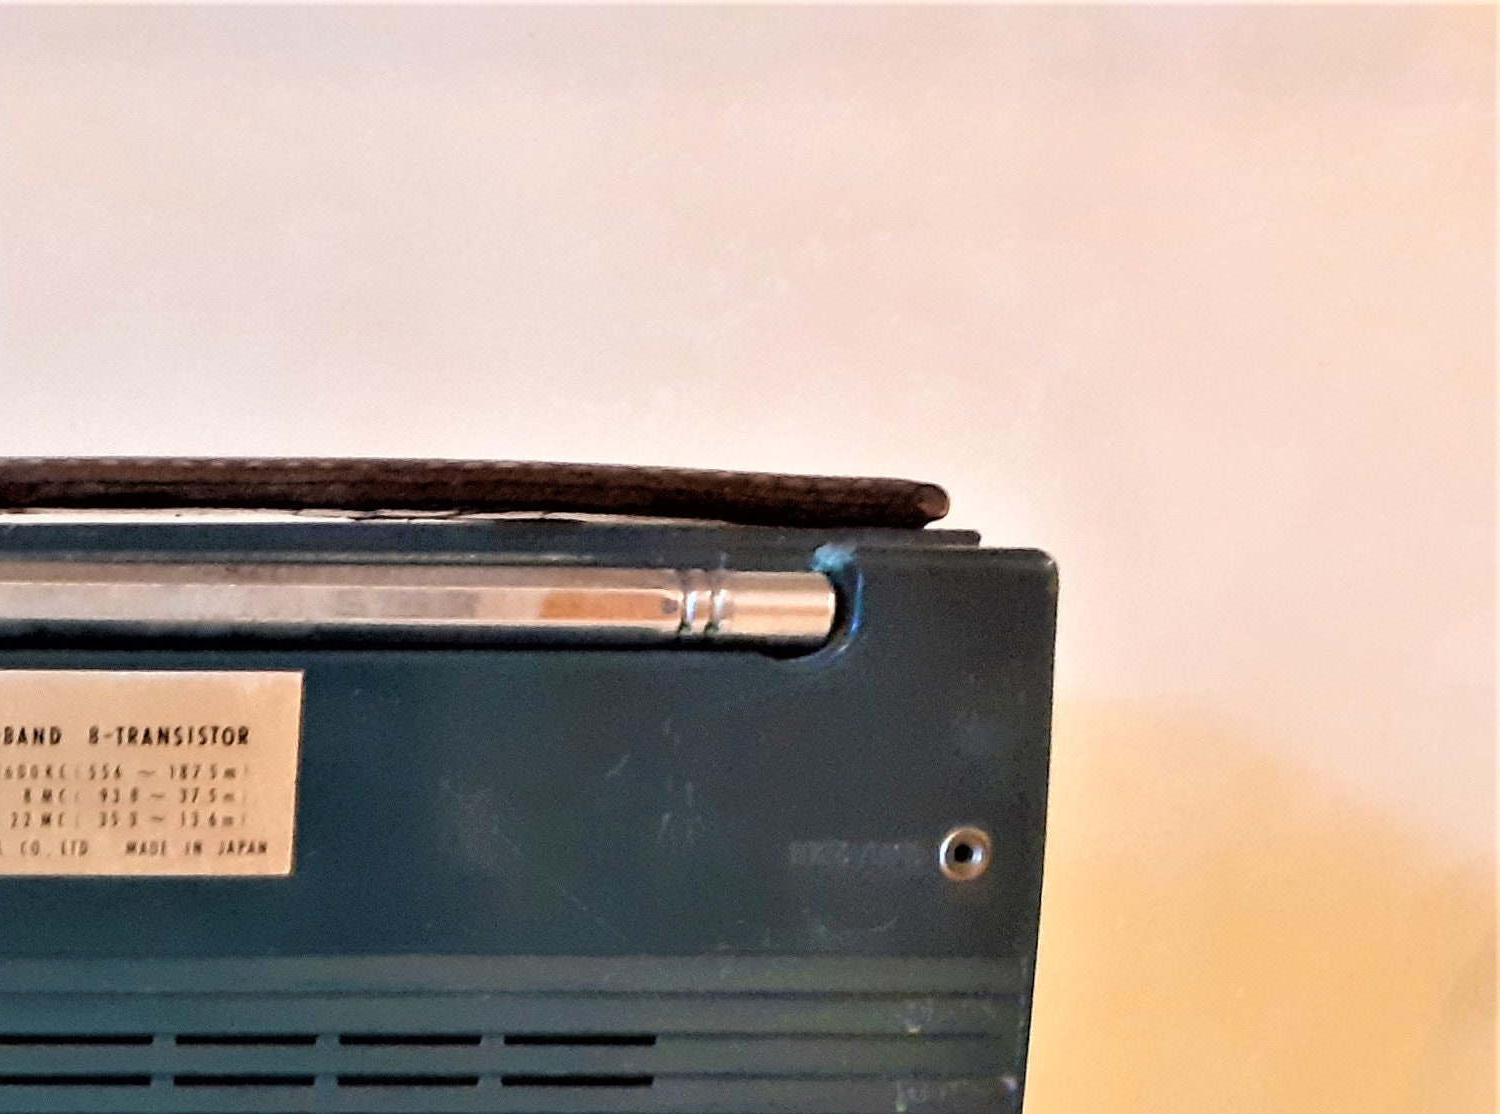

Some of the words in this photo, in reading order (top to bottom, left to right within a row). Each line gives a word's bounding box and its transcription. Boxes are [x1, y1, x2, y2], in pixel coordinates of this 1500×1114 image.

[88, 726, 250, 745] 8-TRANSISTOR
[125, 839, 167, 856] MADE
[184, 839, 203, 856] IN
[217, 839, 268, 857] JAPAN
